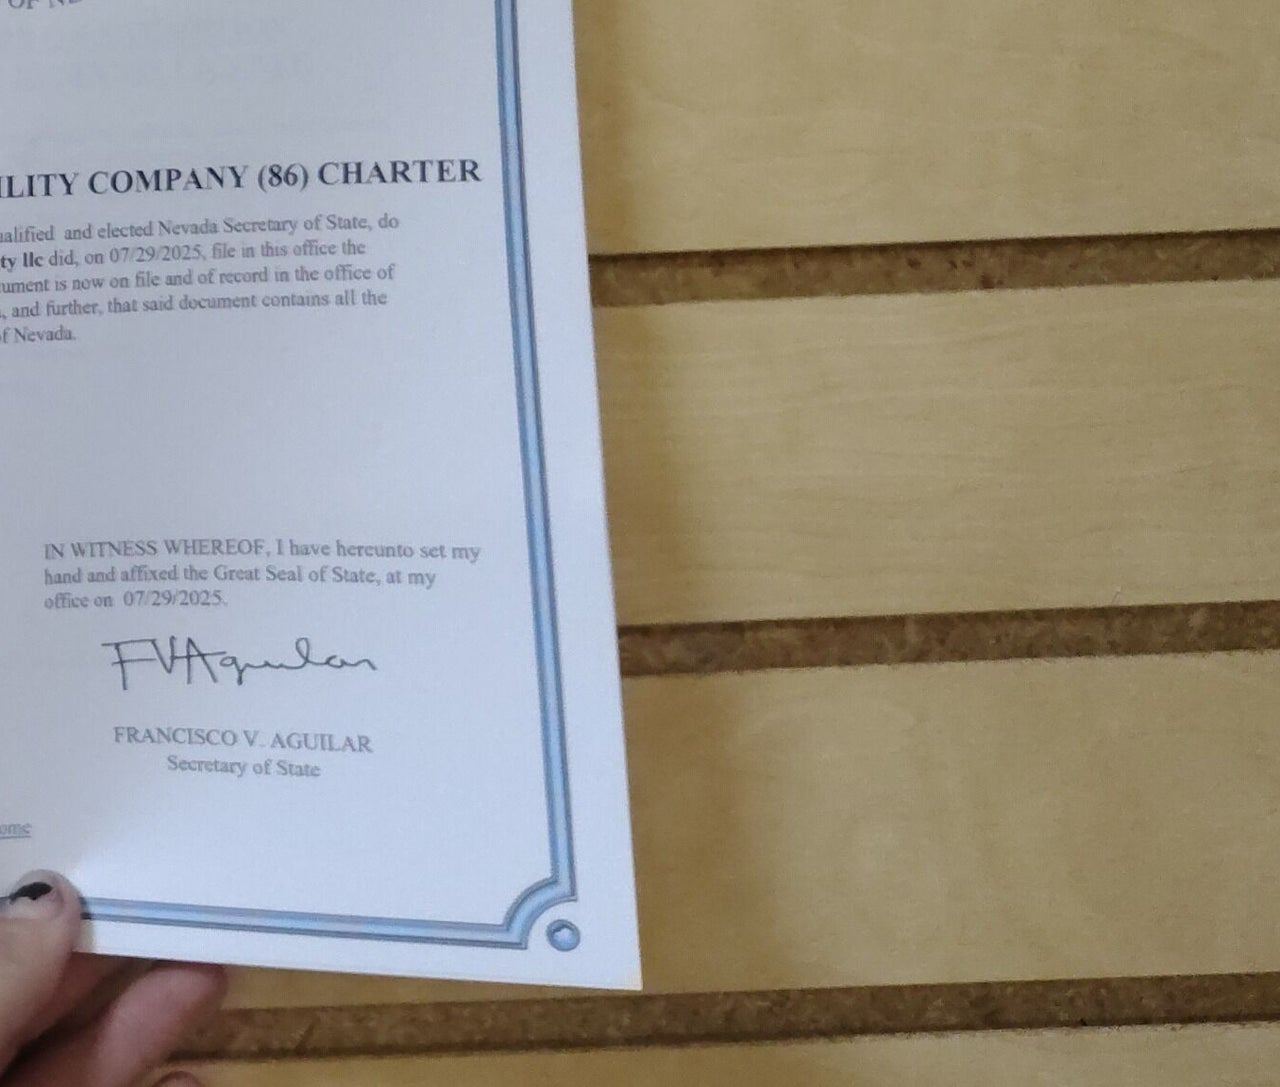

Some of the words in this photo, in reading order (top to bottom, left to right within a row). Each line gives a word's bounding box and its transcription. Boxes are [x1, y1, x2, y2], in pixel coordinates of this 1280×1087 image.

[88, 166, 242, 195] COMPANY
[257, 164, 309, 192] (86)
[318, 159, 481, 185] CHARTER
[22, 251, 44, 268] llc
[84, 252, 104, 265] on
[212, 242, 236, 259] file
[241, 246, 255, 258] in
[260, 241, 288, 257] this
[293, 239, 337, 256] office
[341, 239, 366, 256] the
[113, 726, 239, 747] FRANCISCO
[270, 731, 374, 753] AGUILAR
[167, 754, 248, 779] Secretary
[252, 758, 273, 776] of
[275, 759, 321, 778] State
